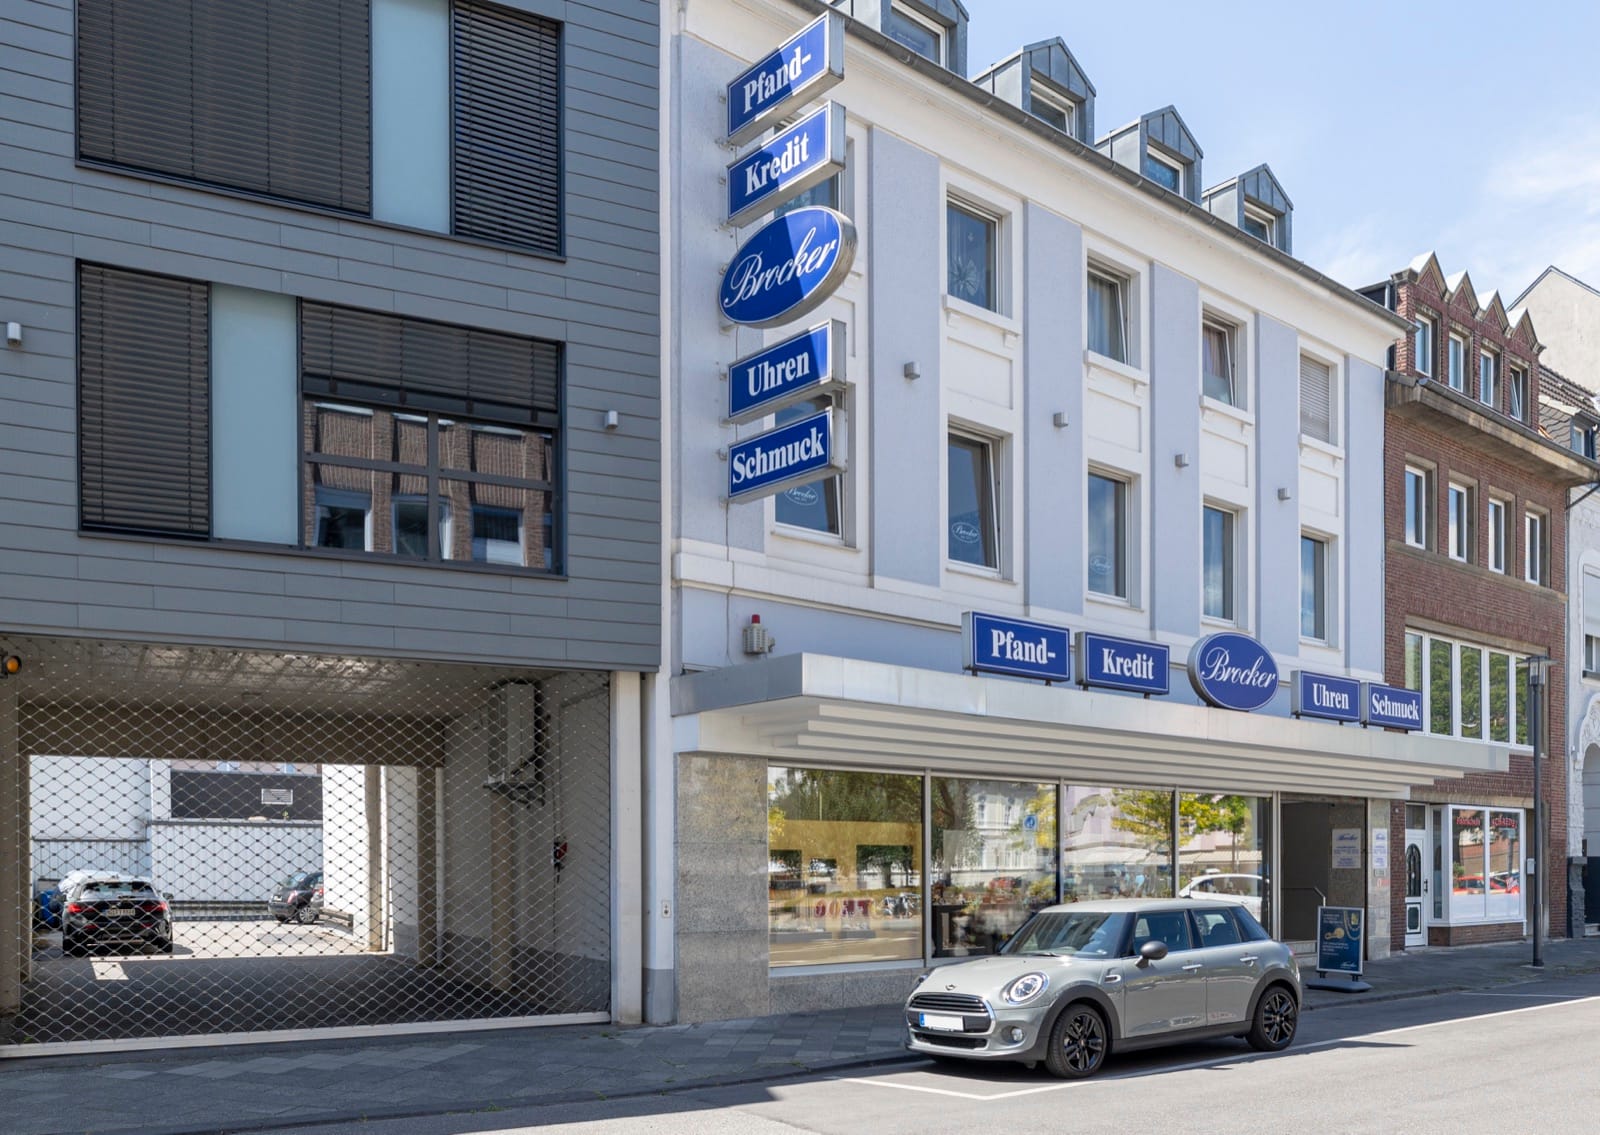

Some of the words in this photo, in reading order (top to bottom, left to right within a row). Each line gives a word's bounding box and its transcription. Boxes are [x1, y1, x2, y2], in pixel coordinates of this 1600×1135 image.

[743, 45, 811, 114] Pfand-
[744, 132, 809, 197] Kredit
[723, 227, 837, 308] Brocker
[746, 351, 810, 397] Uhren
[732, 427, 825, 485] Schmuck
[991, 629, 1056, 664] Pfand-
[1102, 648, 1154, 680] Kredit
[1201, 646, 1276, 688] Brocker
[1312, 683, 1349, 710] Uhren
[1371, 694, 1419, 720] Schmuck
